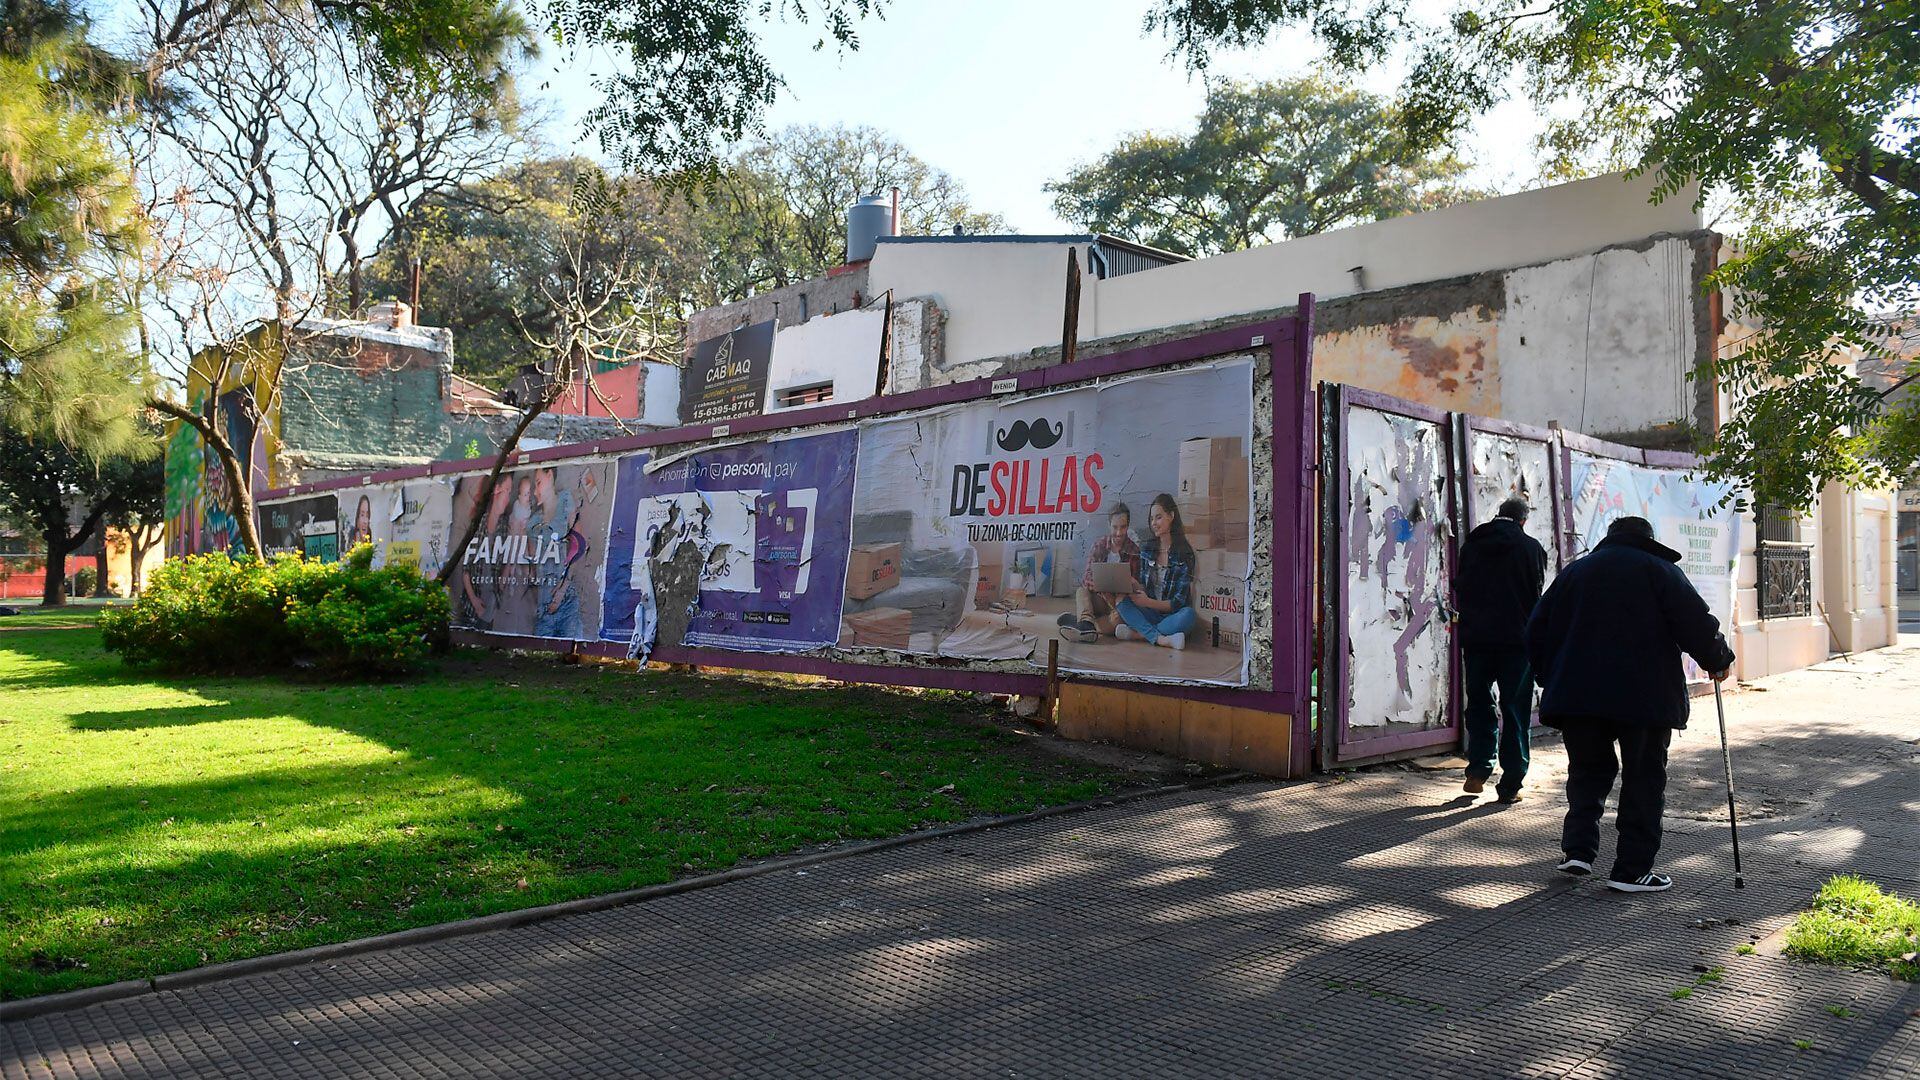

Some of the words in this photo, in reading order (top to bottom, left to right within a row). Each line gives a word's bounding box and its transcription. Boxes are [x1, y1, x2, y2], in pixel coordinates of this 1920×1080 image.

[706, 359, 751, 382] CABMAQ
[992, 381, 1015, 391] AVENIDA
[692, 399, 755, 419] 15-6395-8716
[659, 468, 689, 482] Ahorra
[773, 460, 798, 482] pay
[950, 452, 1104, 517] DESILLAS
[967, 524, 980, 542] TU
[982, 523, 1009, 542] ZONA
[1012, 523, 1026, 541] DE
[1027, 521, 1077, 541] CONFORT
[471, 576, 494, 584] CERCA
[779, 591, 791, 599] VISA
